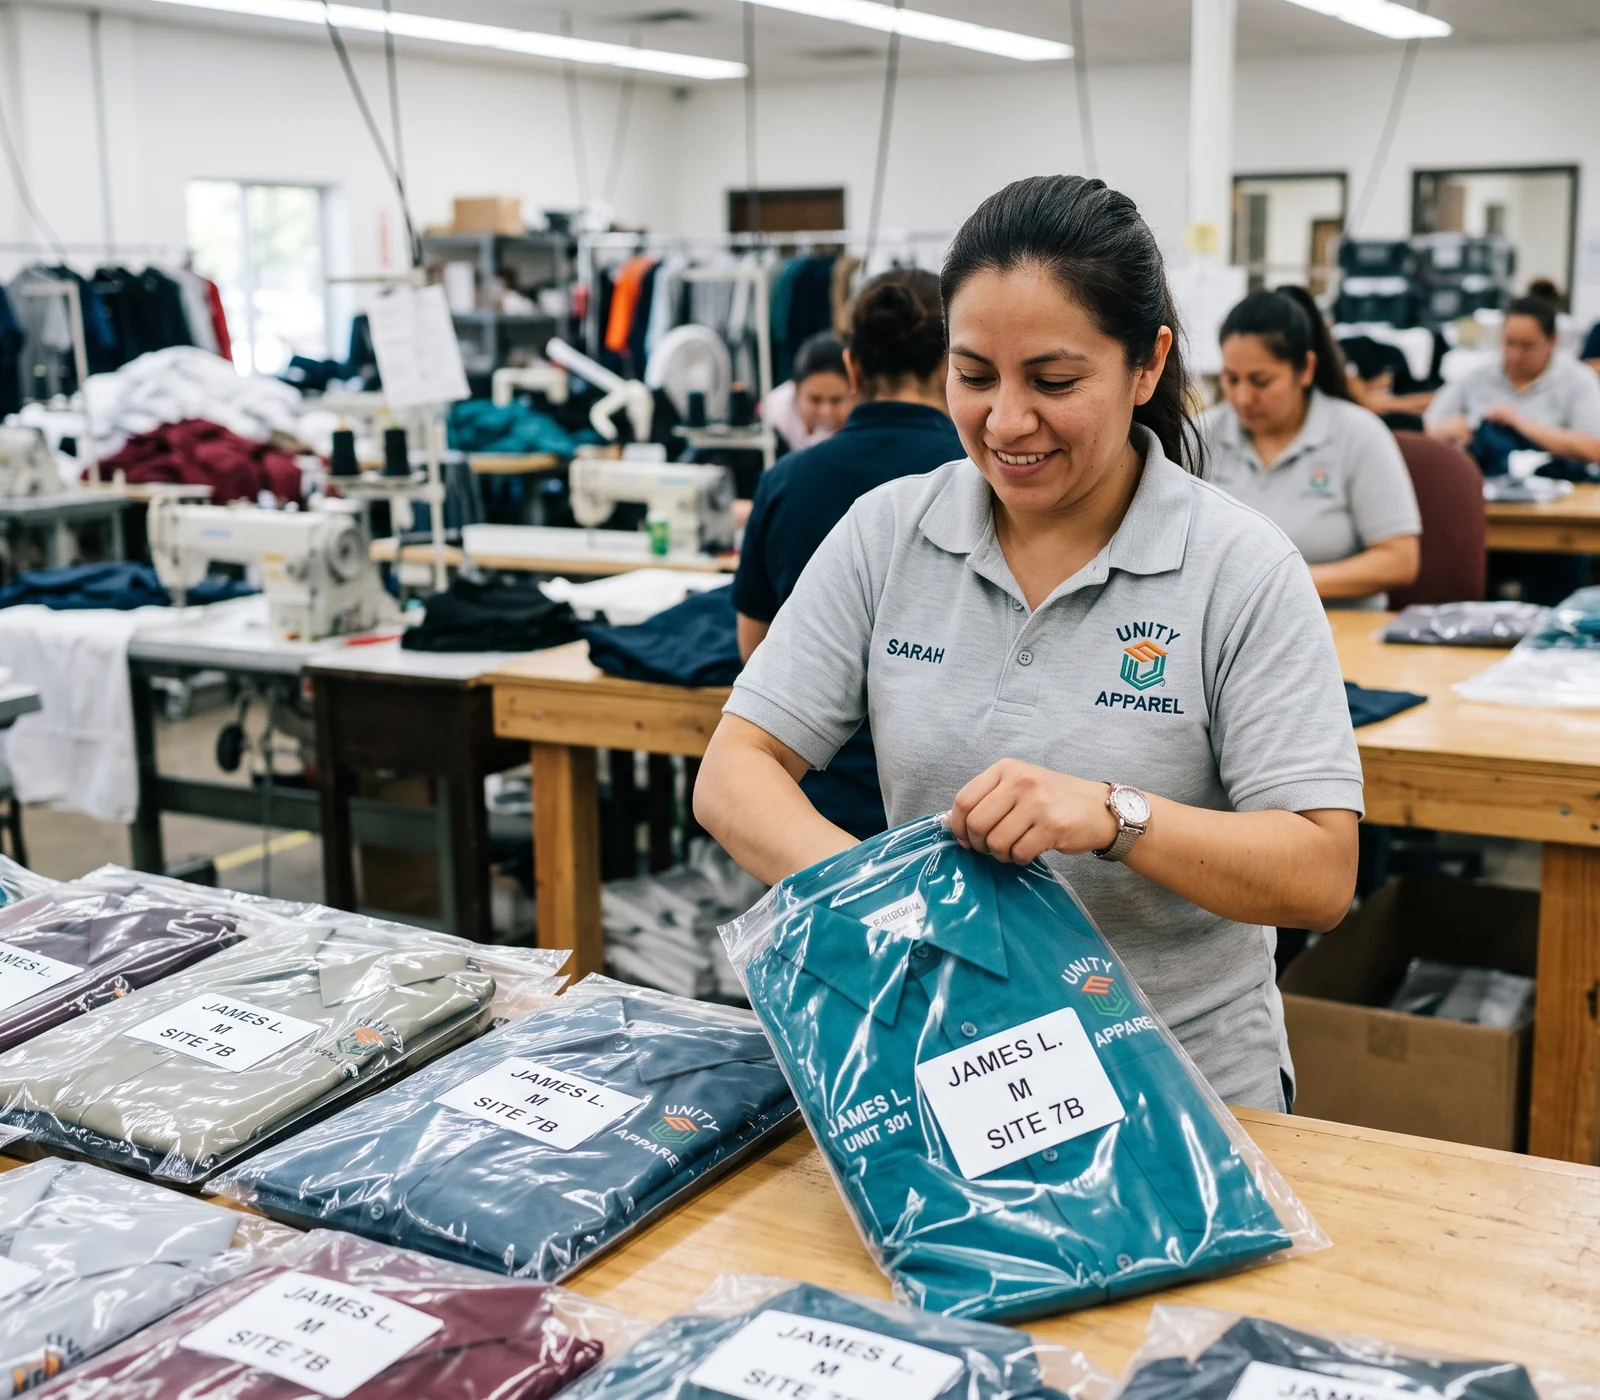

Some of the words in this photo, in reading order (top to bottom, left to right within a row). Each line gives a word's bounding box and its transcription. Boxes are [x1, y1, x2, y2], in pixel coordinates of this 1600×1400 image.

[1115, 621, 1181, 644] UNITY
[886, 638, 945, 664] SARAH
[1094, 690, 1185, 715] APPAREL
[37, 966, 50, 977] L.
[1061, 956, 1113, 985] UNITY
[201, 1003, 270, 1027] JAMES
[267, 1021, 284, 1034] L.
[209, 1023, 234, 1035] M
[159, 1028, 209, 1048] SITE
[207, 1042, 237, 1058] 7B
[948, 1039, 1034, 1088] JAMES
[1036, 1032, 1063, 1052] L.
[510, 1069, 588, 1098] JAMES
[586, 1094, 605, 1108] L.
[524, 1093, 550, 1107] M
[1007, 1077, 1033, 1103] M
[473, 1097, 527, 1121] SITE
[526, 1115, 560, 1134] 7B
[664, 1104, 720, 1132] UNITY
[828, 1095, 890, 1138] JAMES
[890, 1088, 911, 1107] L.
[986, 1110, 1047, 1150] SITE
[1048, 1097, 1085, 1120] 7B
[843, 1124, 881, 1152] UNIT
[884, 1110, 913, 1135] 301
[613, 1129, 680, 1169] APPARE
[284, 1287, 374, 1321] JAMES
[374, 1311, 397, 1334] L.
[295, 1317, 326, 1335] M
[227, 1329, 290, 1361] SITE
[290, 1347, 331, 1373] 7B
[777, 1326, 884, 1361] JAMES
[890, 1354, 914, 1375] L.
[743, 1368, 817, 1399] SITE
[811, 1360, 842, 1378] M
